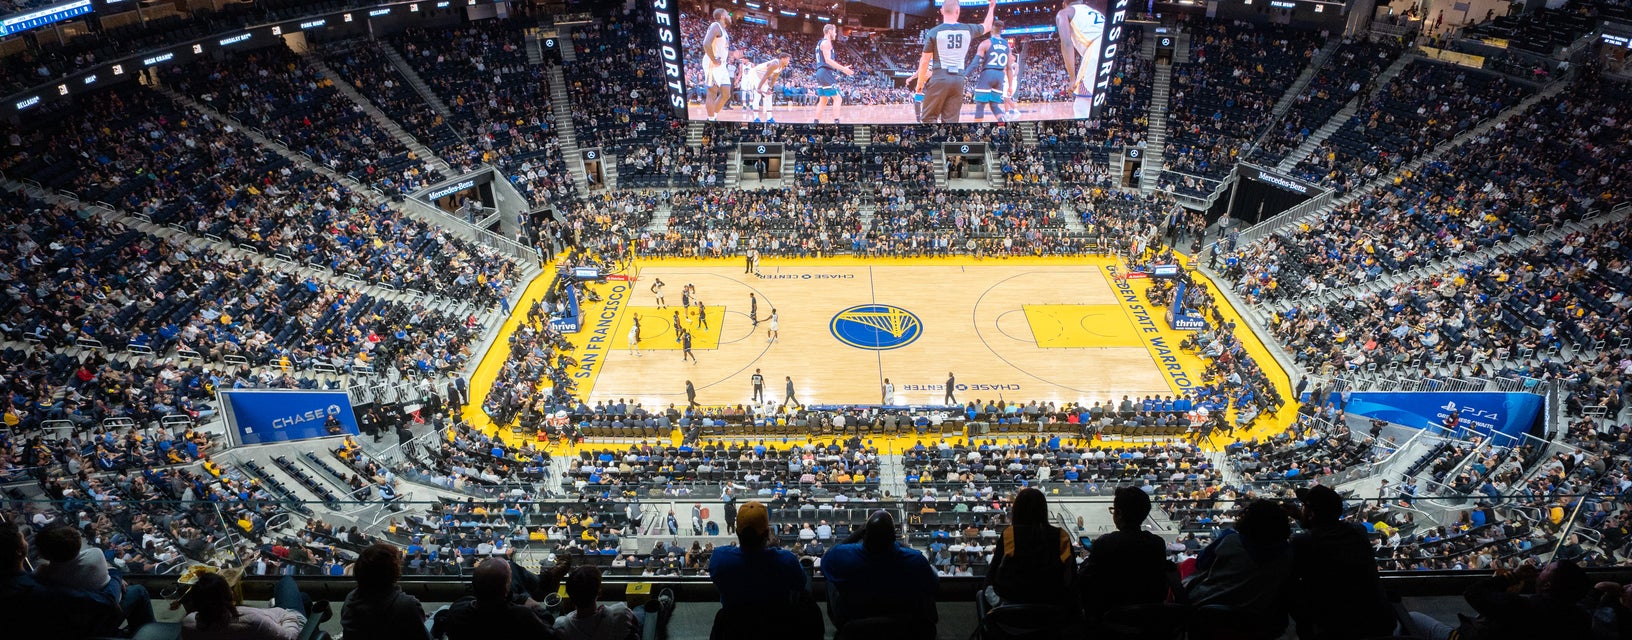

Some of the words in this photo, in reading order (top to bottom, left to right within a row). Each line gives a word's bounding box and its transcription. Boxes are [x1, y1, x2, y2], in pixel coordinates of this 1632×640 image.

[947, 33, 962, 49] 39
[988, 52, 1008, 67] 20
[428, 179, 475, 201] Mercedes-Benz
[1258, 171, 1307, 193] Mercedes-Benz
[550, 321, 577, 330] hrive
[585, 285, 627, 351] FRANCISCO
[1129, 304, 1159, 333] STATE
[1175, 319, 1204, 327] thrive
[575, 353, 599, 379] SAN
[272, 408, 325, 430] CHASE
